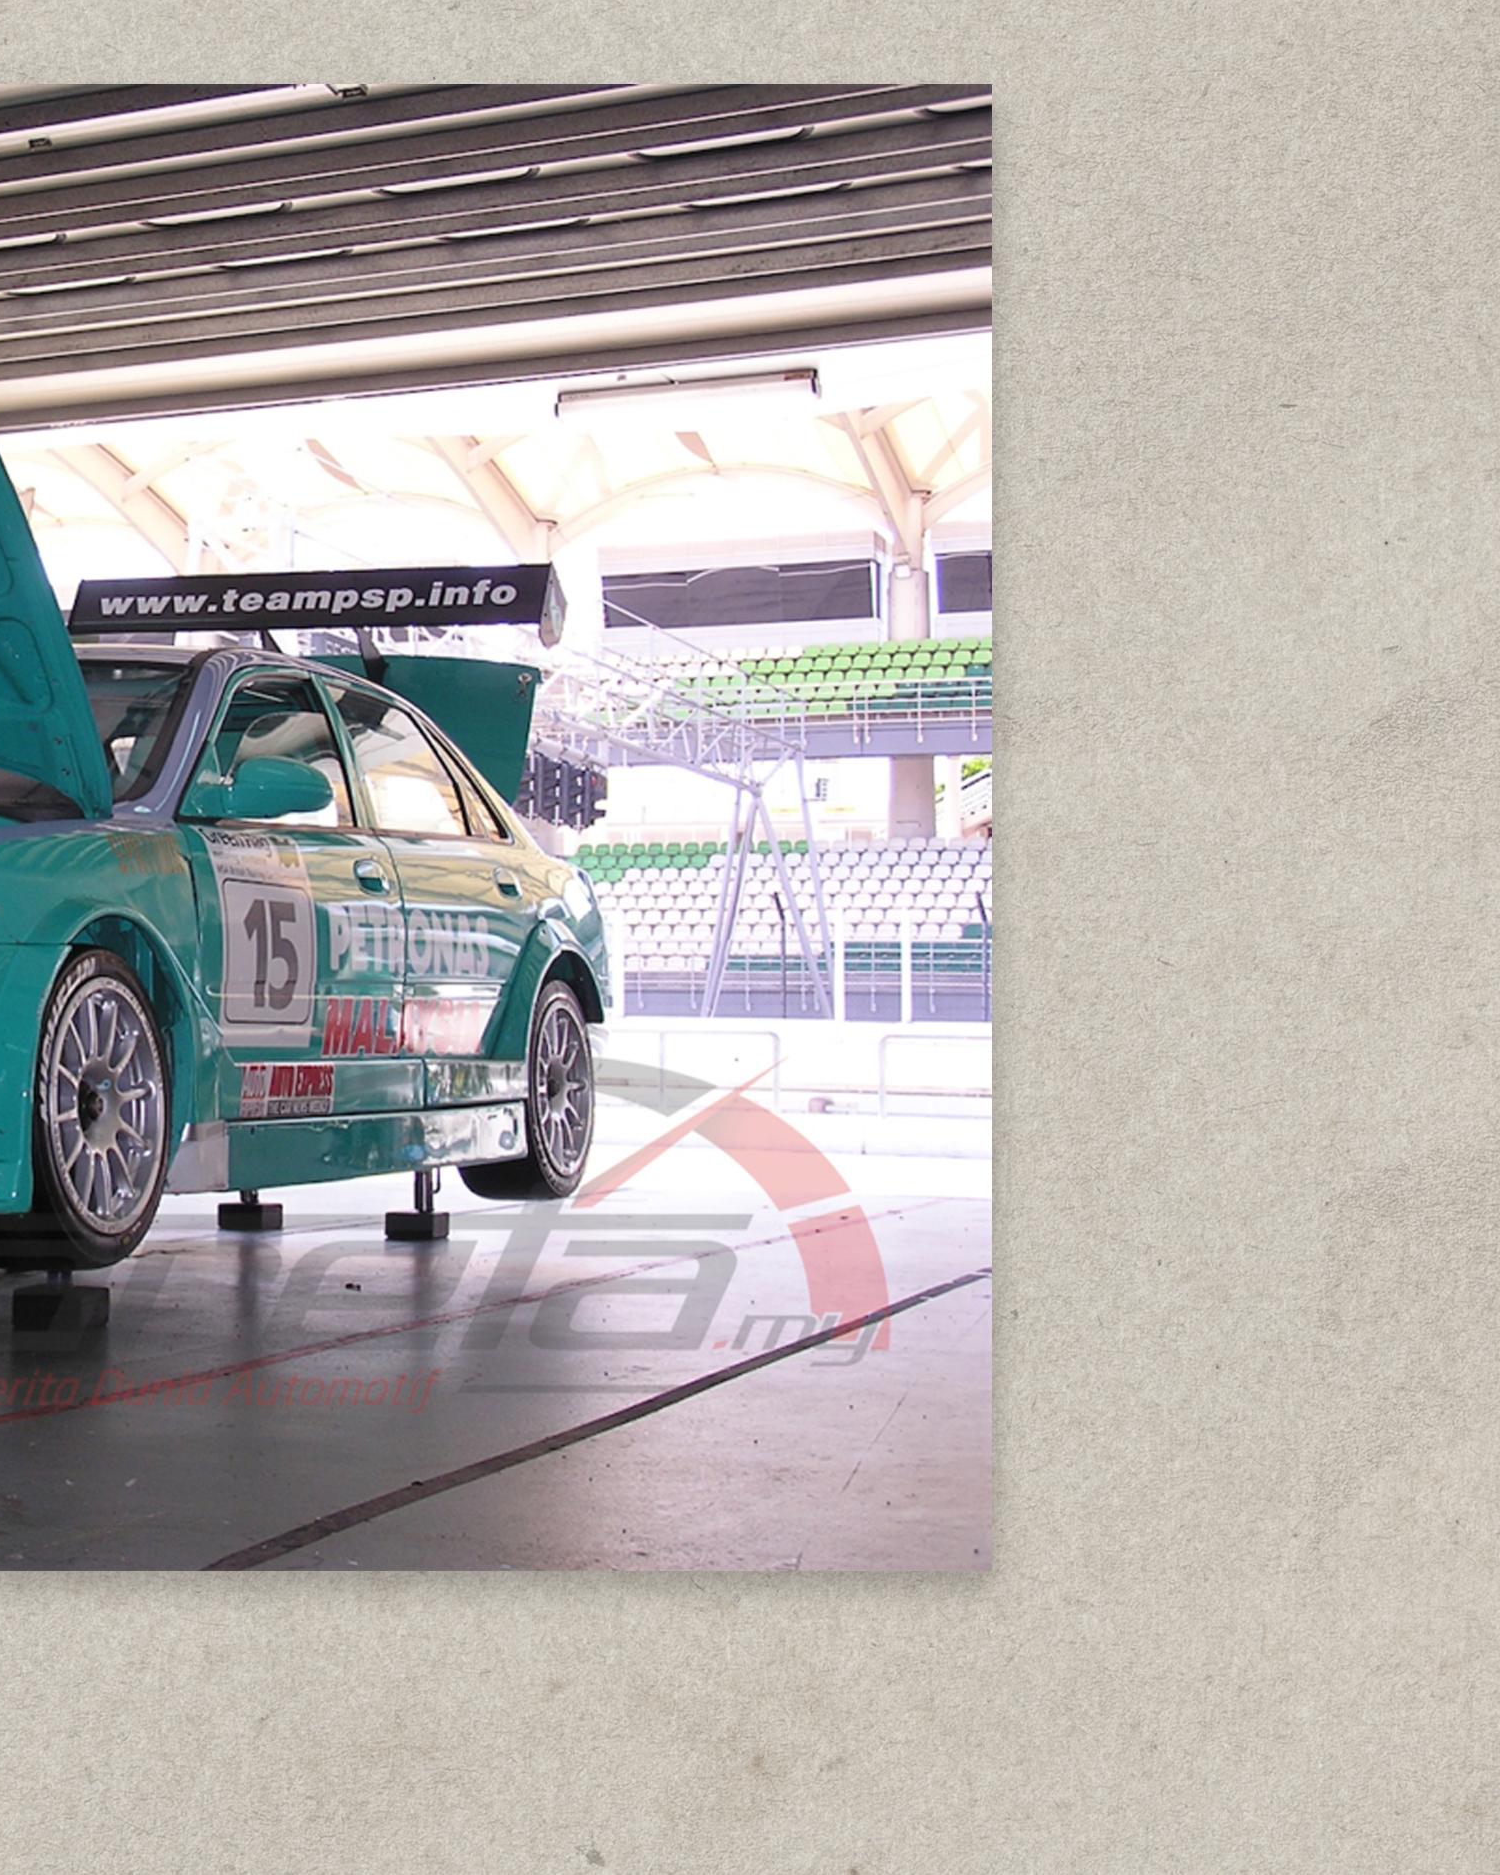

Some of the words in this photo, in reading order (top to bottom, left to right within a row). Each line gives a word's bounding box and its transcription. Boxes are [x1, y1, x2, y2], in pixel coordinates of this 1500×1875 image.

[99, 578, 518, 617] www.teampsp.info
[243, 898, 298, 1011] 15
[328, 903, 489, 978] PETRONAS
